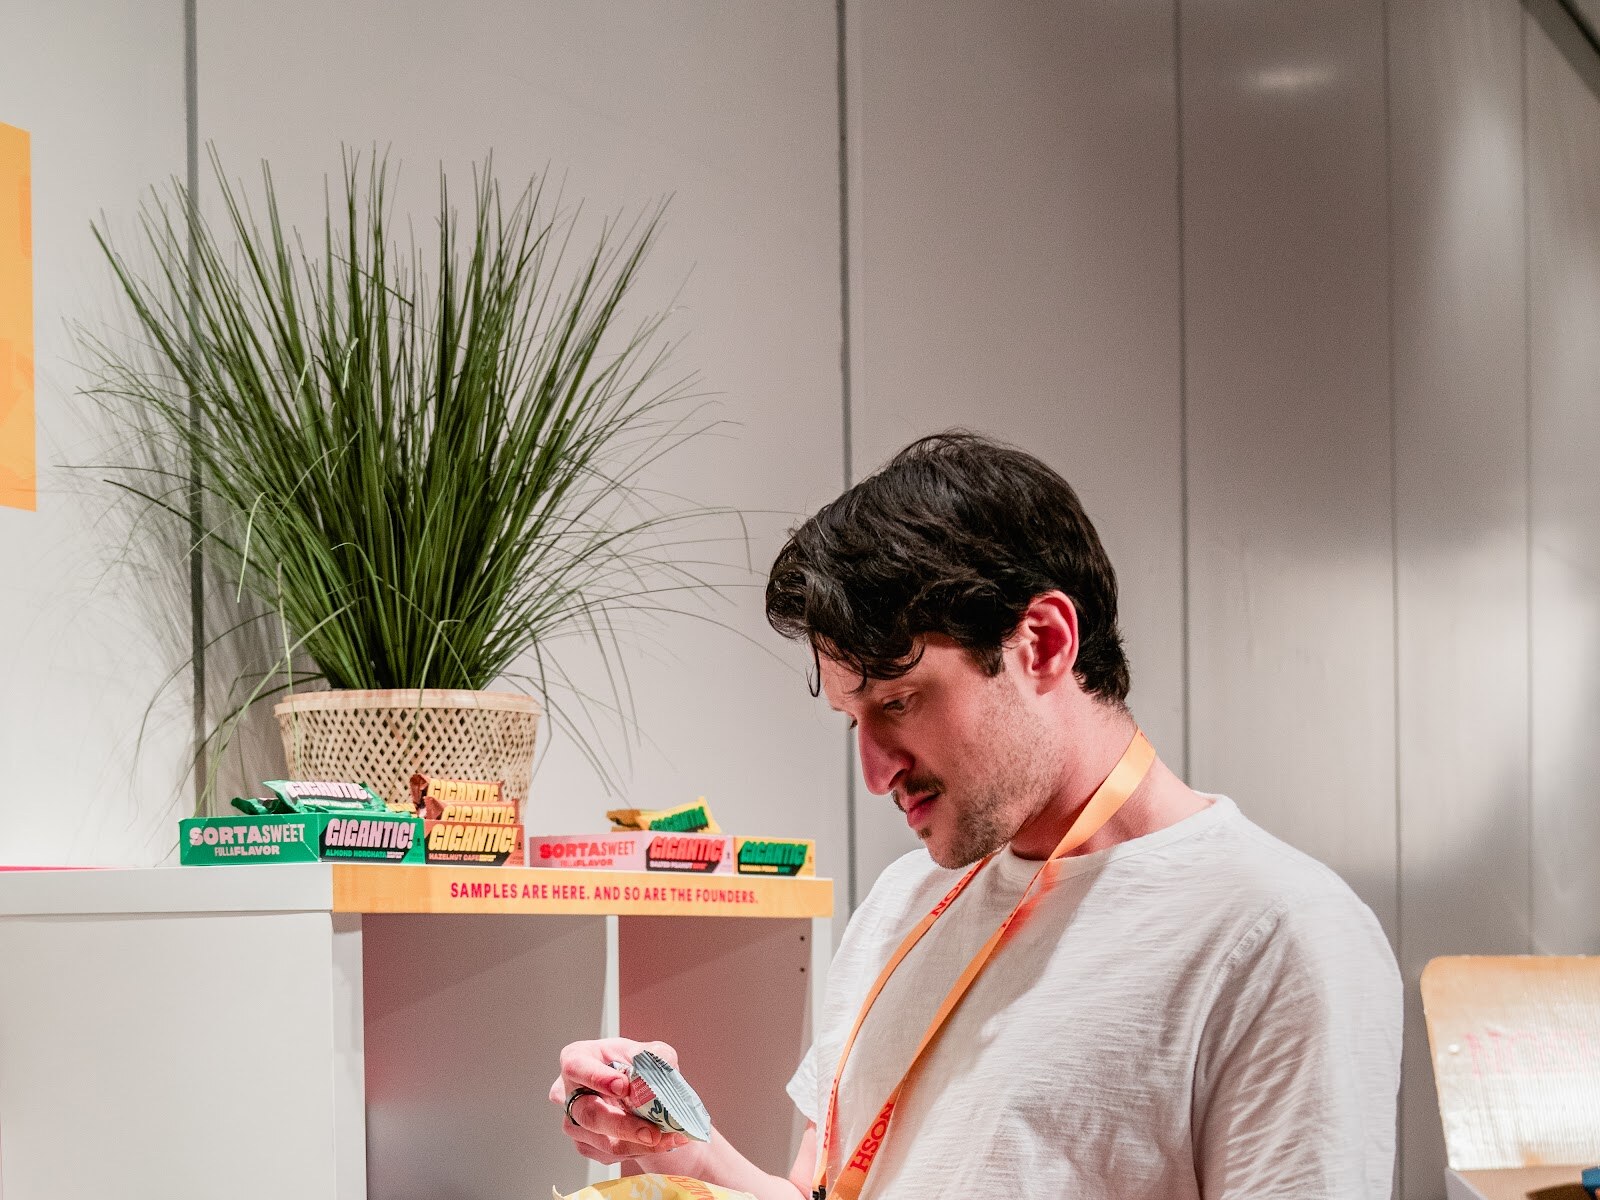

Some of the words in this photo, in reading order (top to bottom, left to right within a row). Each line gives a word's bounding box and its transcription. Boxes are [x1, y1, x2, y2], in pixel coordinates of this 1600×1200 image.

[325, 818, 416, 849] GIGANTIC!
[428, 823, 519, 854] GIGANTIC!
[451, 882, 518, 899] SAMPLES
[522, 884, 548, 899] ARE
[552, 885, 590, 900] HERE.
[594, 886, 621, 900] AND
[624, 886, 641, 900] SO
[644, 887, 667, 901] ARE
[670, 888, 692, 901] THE
[696, 888, 759, 904] FOUNDERS.
